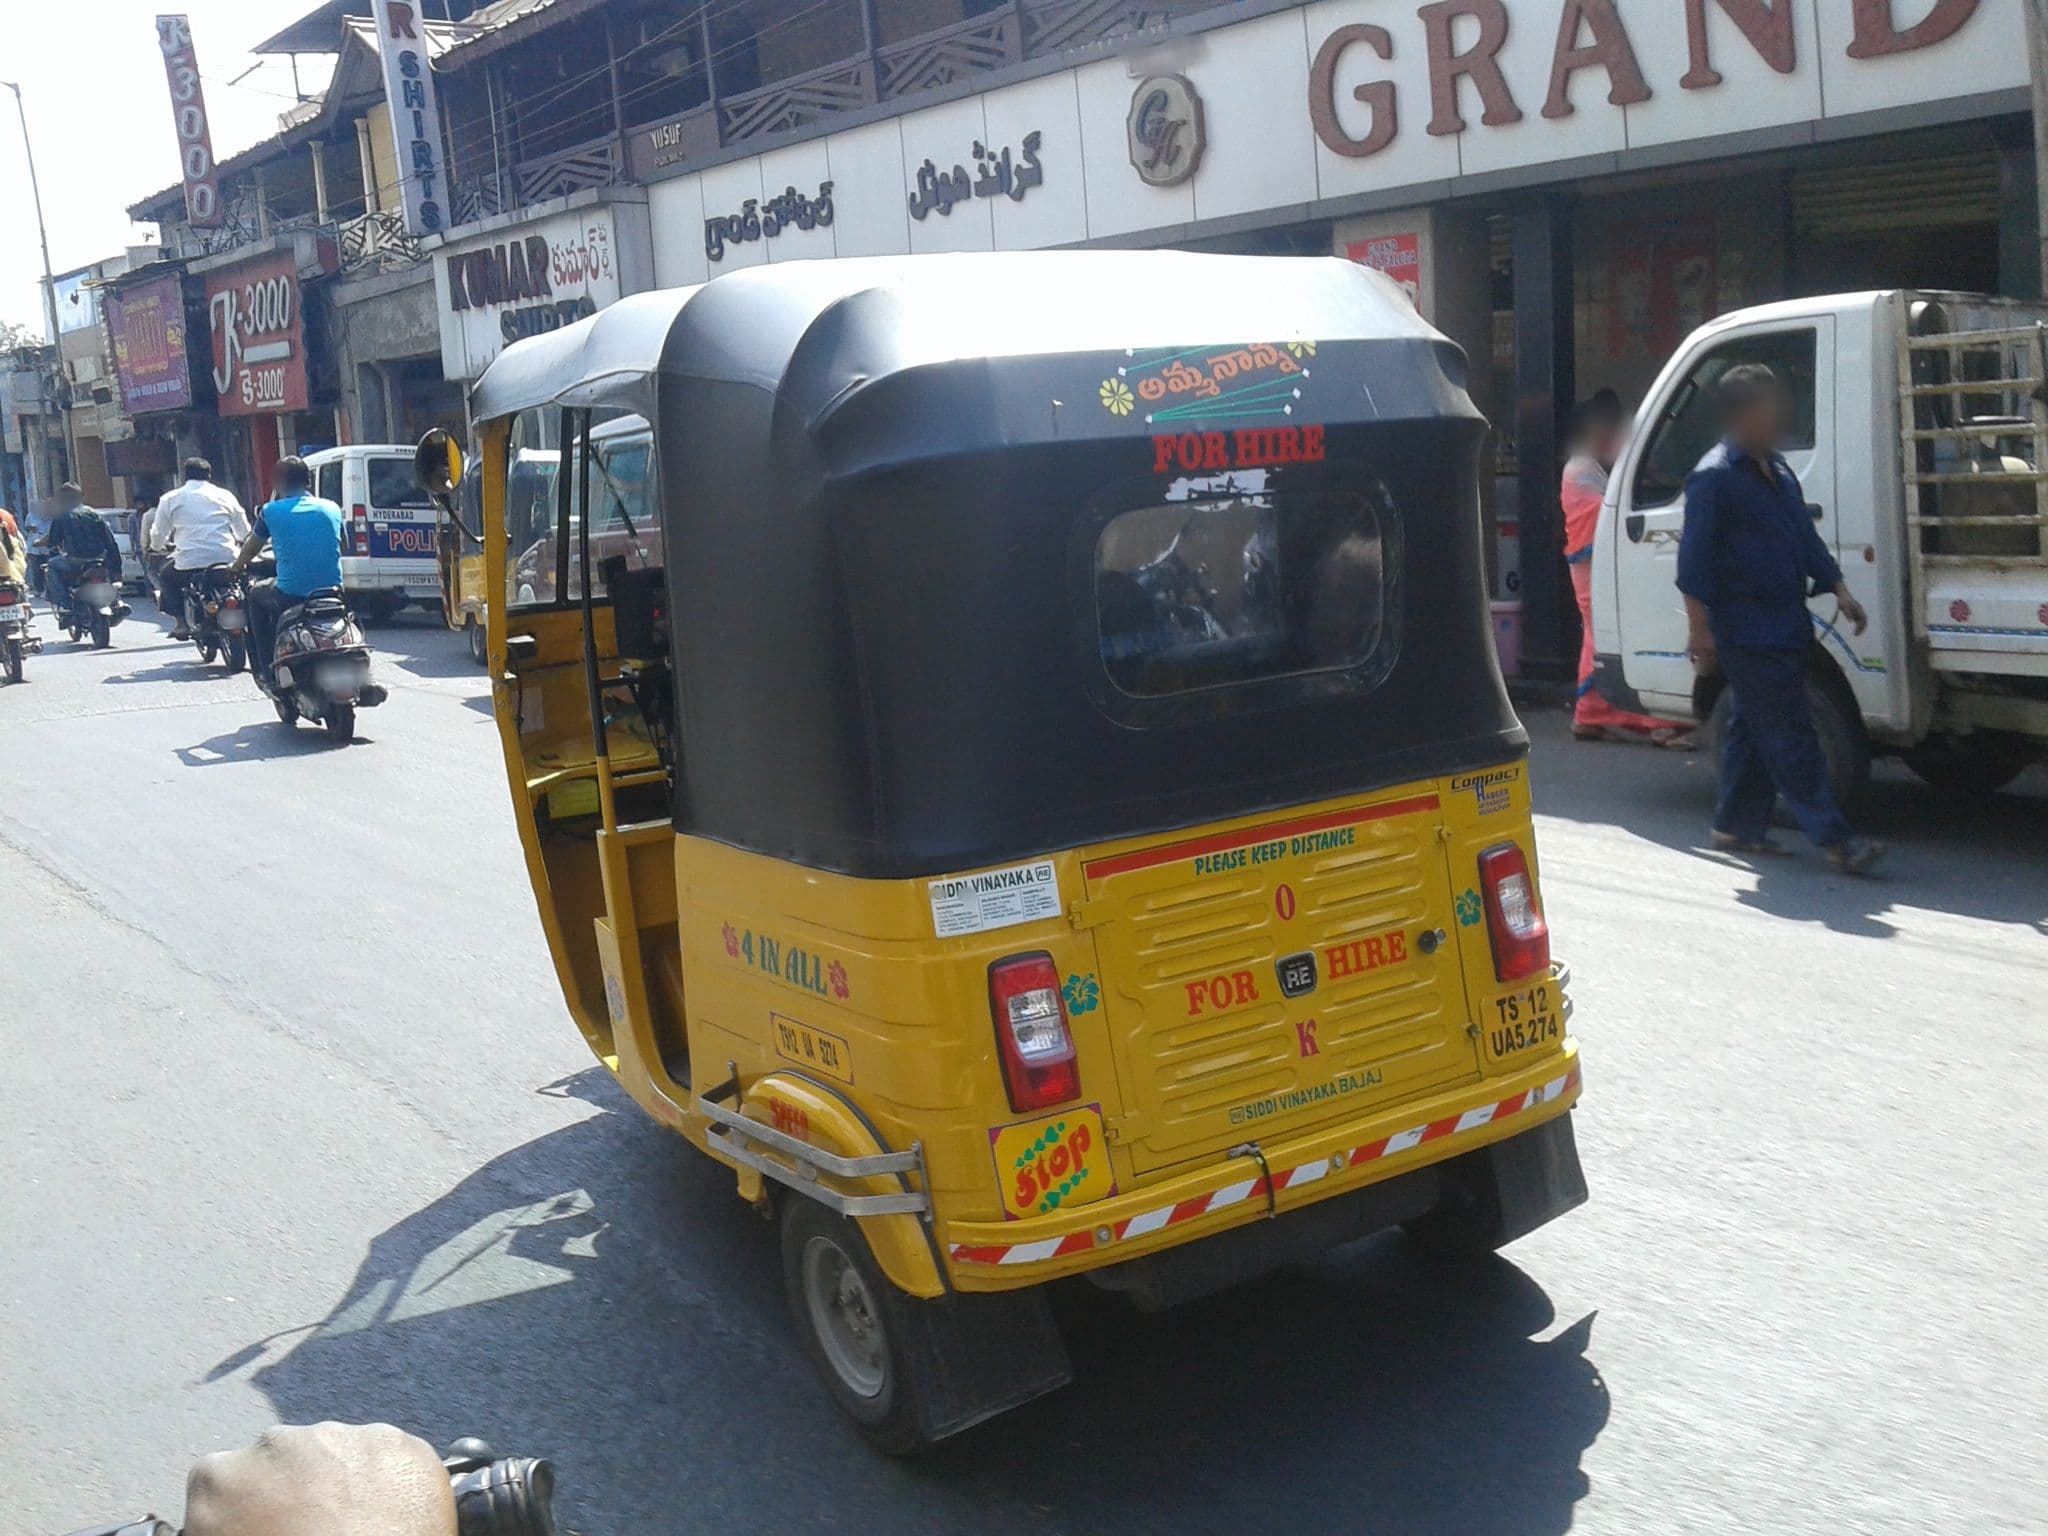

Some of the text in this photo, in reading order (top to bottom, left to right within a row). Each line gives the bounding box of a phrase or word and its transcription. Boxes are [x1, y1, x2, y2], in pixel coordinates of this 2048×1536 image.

[398, 50, 440, 229] SHIRTS
[650, 123, 681, 149] YUSUF
[447, 236, 553, 312] KUMAR
[210, 275, 291, 395] K-3000
[1152, 424, 1326, 472] FOR HIRE
[373, 510, 414, 519] HYDERABAD
[1195, 828, 1355, 876] PLEASE KEEP DISTANCE
[972, 868, 1034, 893] VINAYAKA
[742, 929, 827, 996] 4 IN ALL
[1184, 930, 1408, 1016] FOR HIRE
[1285, 965, 1312, 989] RE
[1496, 986, 1548, 1024] TS 12
[1296, 1019, 1320, 1058] K
[1246, 1099, 1278, 1120] SIDDI
[1279, 1082, 1338, 1110] VINAYAKA
[1338, 1068, 1383, 1094] BAJAJ
